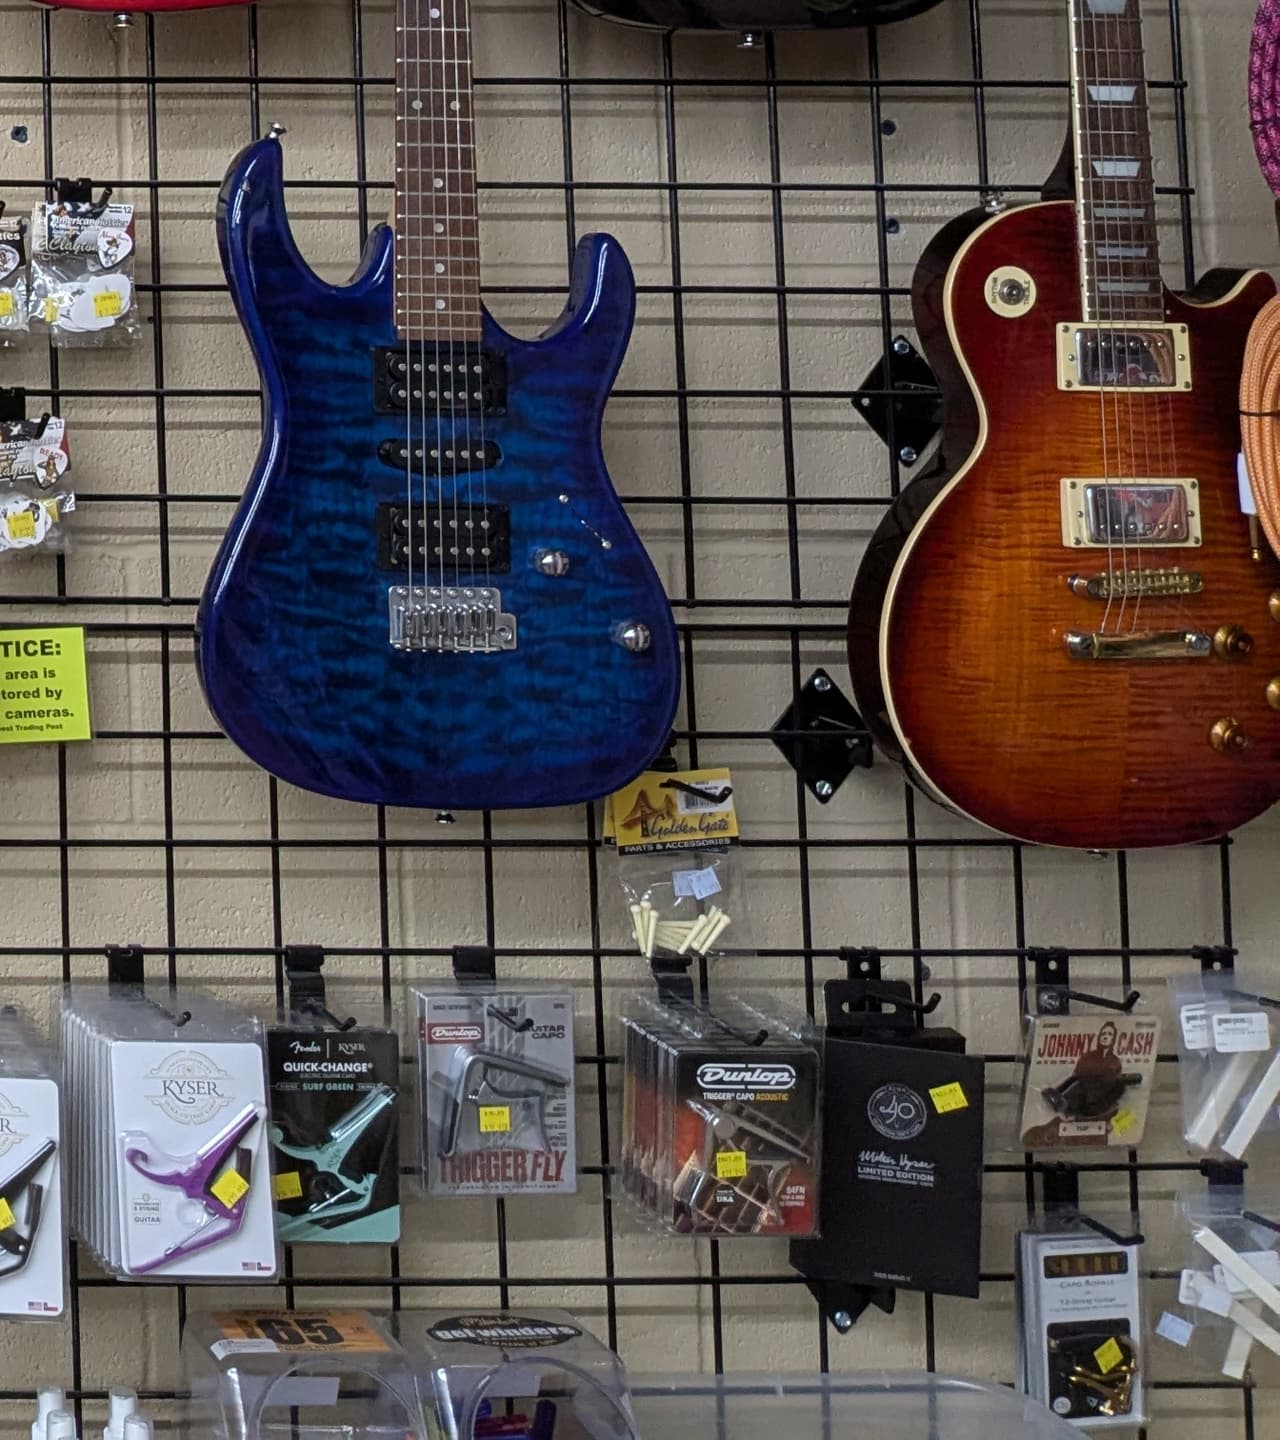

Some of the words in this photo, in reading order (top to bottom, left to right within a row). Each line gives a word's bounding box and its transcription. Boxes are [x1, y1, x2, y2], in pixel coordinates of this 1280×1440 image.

[6, 670, 38, 680] area
[43, 668, 56, 678] is
[45, 687, 62, 700] by
[5, 708, 74, 720] cameras.
[15, 724, 44, 732] Trading
[651, 814, 698, 839] Golden
[698, 813, 729, 835] Gate
[625, 845, 654, 853] PARTS
[665, 839, 731, 850] ACCESSORIES
[434, 1027, 480, 1040] Dunlop
[531, 1032, 566, 1040] CAPO
[289, 1040, 321, 1054] Fender
[1038, 1033, 1097, 1058] JOHNNY
[1118, 1031, 1155, 1056] CASH
[703, 1068, 792, 1085] Dunlop
[162, 1079, 224, 1104] KYSER
[302, 1082, 324, 1091] SURF
[325, 1082, 354, 1091] GREEN
[736, 1092, 755, 1101] CAPO
[440, 1150, 529, 1184] TRIGGER
[530, 1149, 568, 1183] FLY
[858, 1166, 894, 1178] LIMITED
[896, 1170, 935, 1182] EDITION
[254, 1317, 346, 1346] 65
